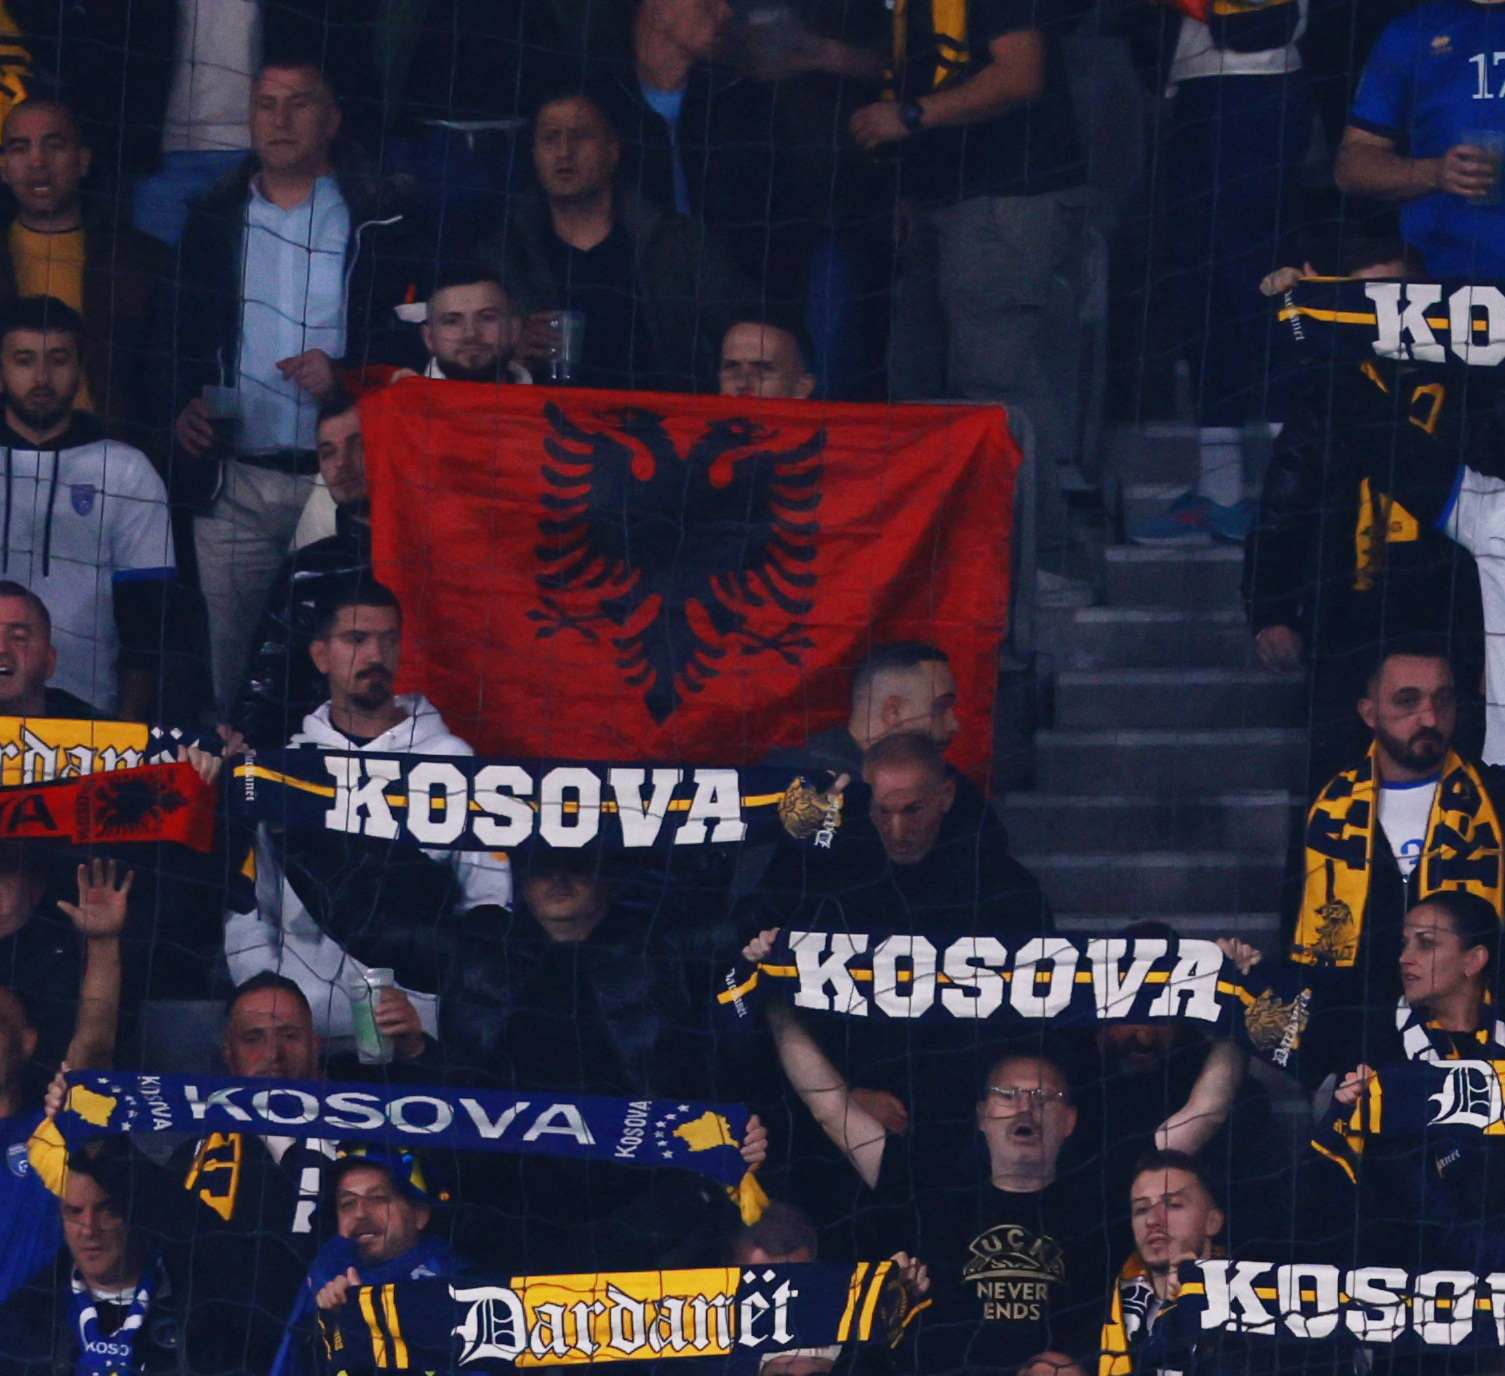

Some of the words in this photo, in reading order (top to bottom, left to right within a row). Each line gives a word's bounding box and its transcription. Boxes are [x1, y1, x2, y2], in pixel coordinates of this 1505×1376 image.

[324, 755, 747, 848] KOSOVA
[788, 931, 1227, 1022] KOSOVA
[191, 1083, 595, 1147] KOSOVA
[614, 1101, 653, 1159] KOSOVA
[449, 1270, 798, 1368] Dardanët
[977, 1281, 1048, 1301] NEVER
[984, 1302, 1041, 1321] ENDS
